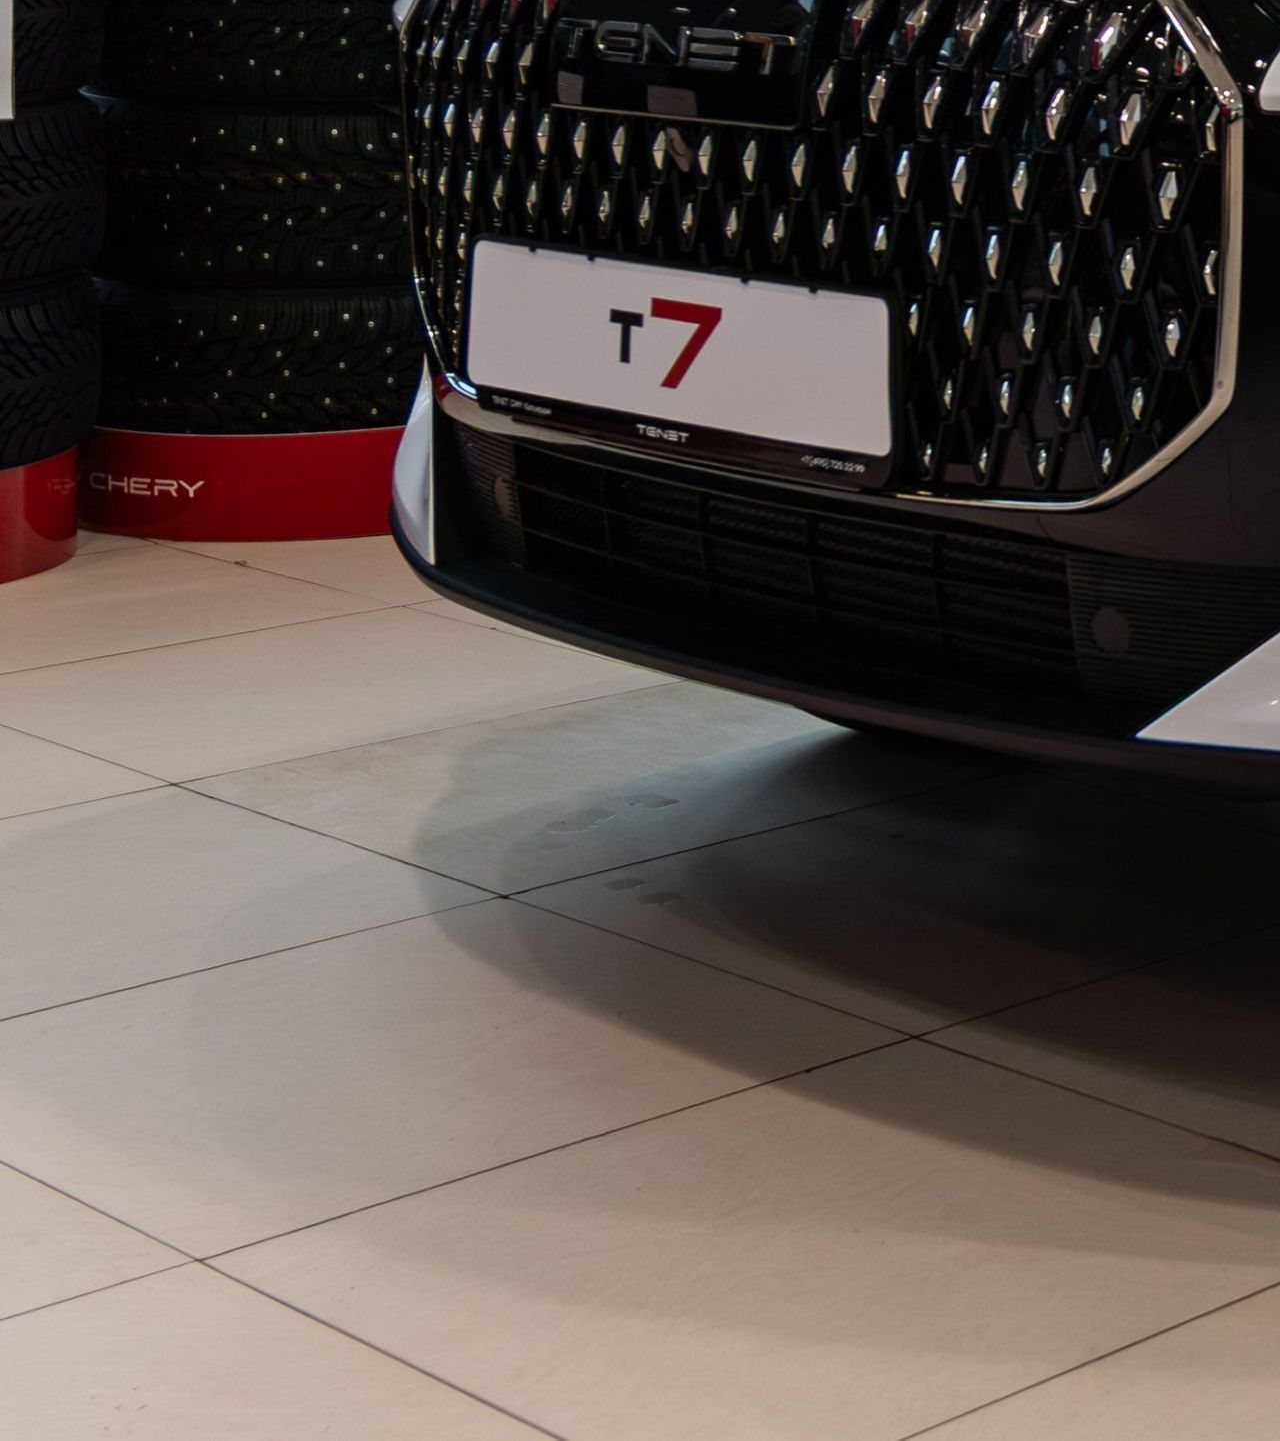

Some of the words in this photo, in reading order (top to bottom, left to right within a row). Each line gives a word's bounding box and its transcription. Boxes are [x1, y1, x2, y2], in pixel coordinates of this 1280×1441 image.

[557, 17, 797, 76] TENET
[609, 297, 722, 389] T7
[636, 424, 690, 443] TENET
[89, 472, 205, 498] CHERY
